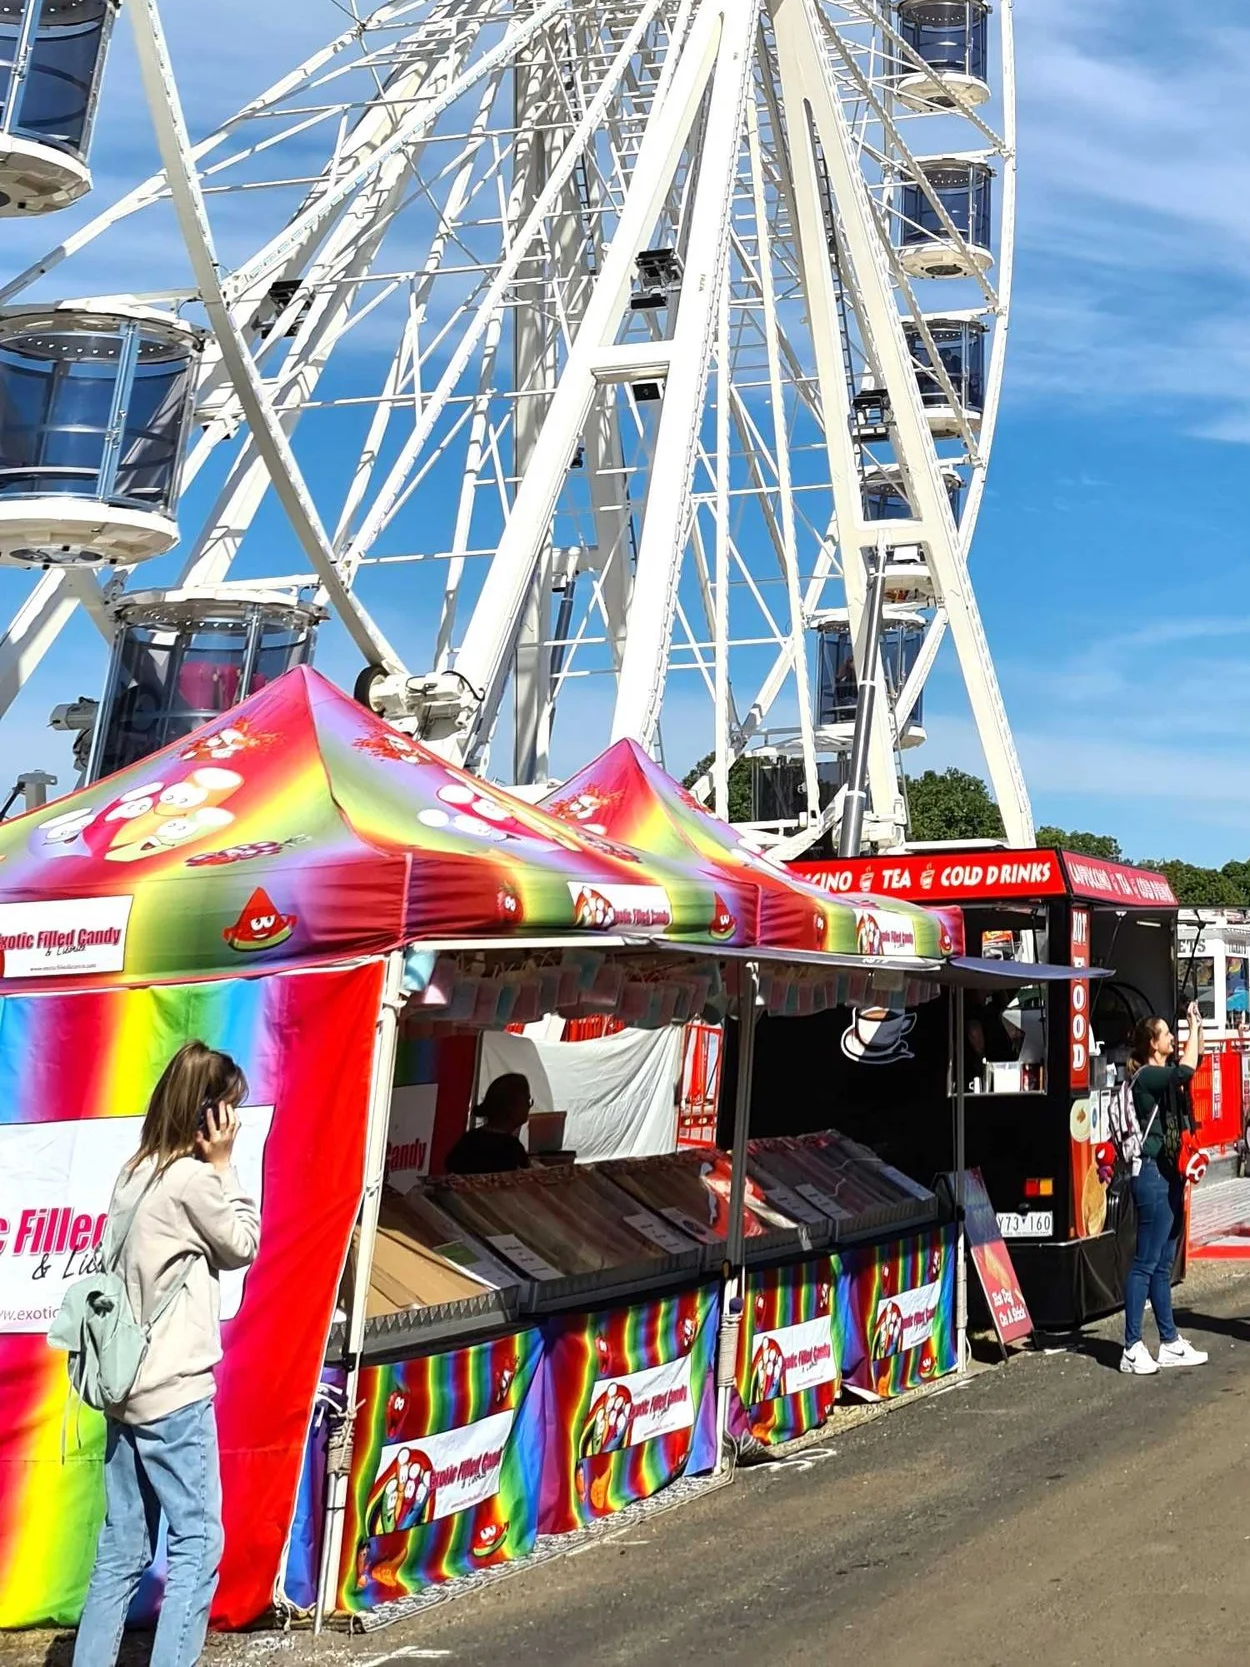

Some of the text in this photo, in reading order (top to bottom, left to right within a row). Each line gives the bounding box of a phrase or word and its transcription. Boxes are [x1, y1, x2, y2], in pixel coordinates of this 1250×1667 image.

[882, 867, 911, 890] TEA
[941, 866, 983, 888] COLD
[986, 861, 1051, 885] DRINKS
[36, 928, 76, 949] Filled
[77, 927, 122, 947] Candy
[1073, 911, 1087, 946] HOT
[1030, 1216, 1051, 1231] 160
[32, 1253, 52, 1280] &
